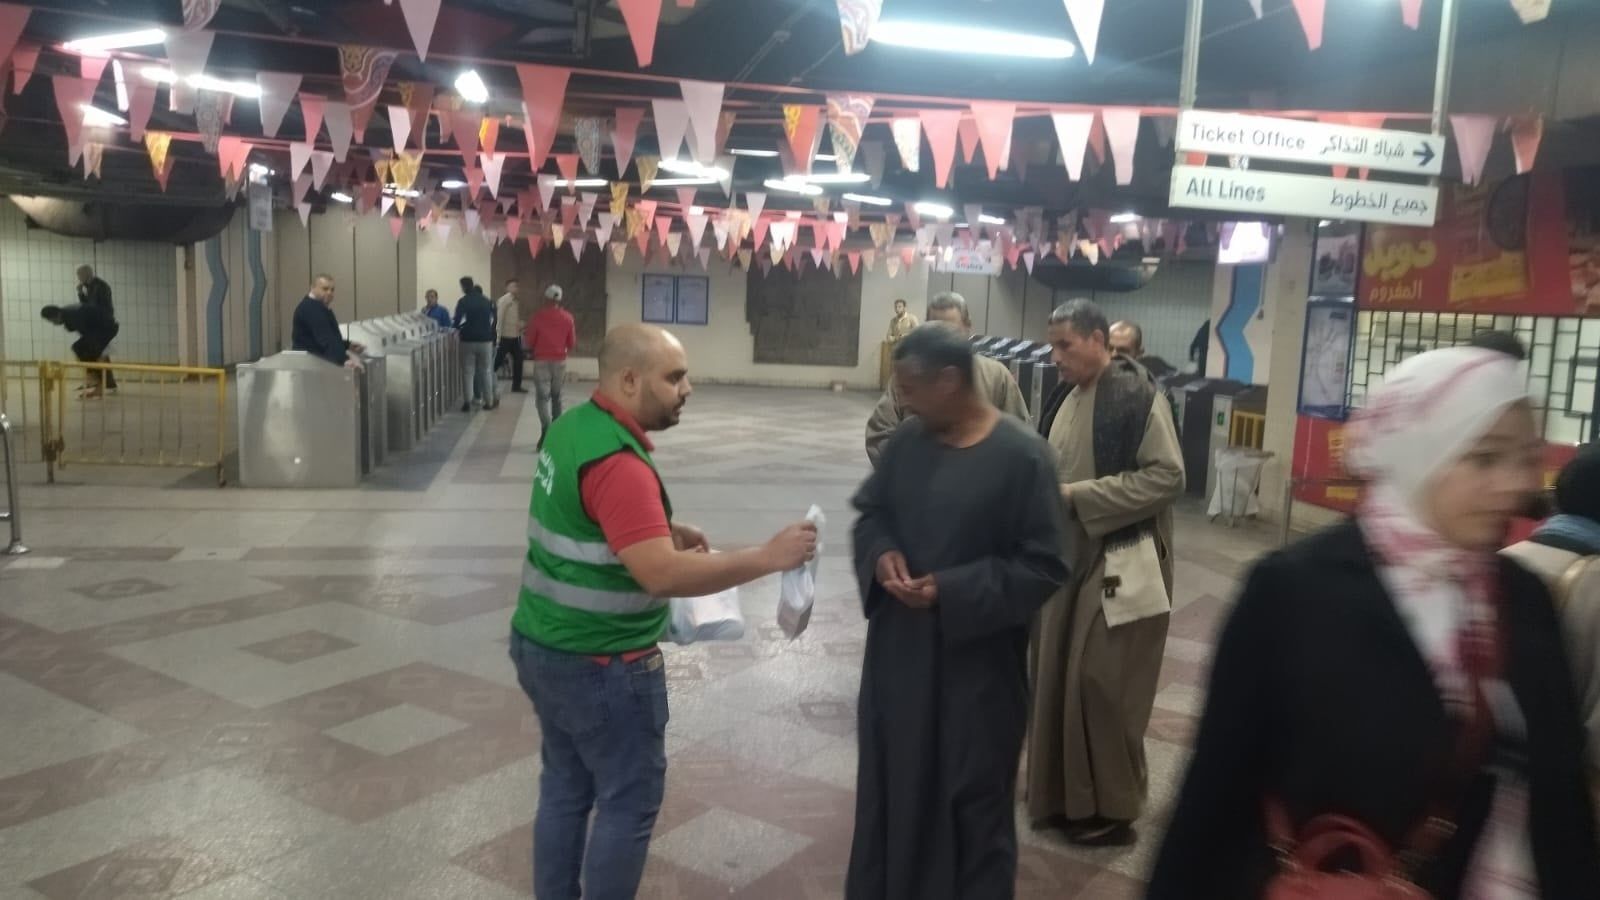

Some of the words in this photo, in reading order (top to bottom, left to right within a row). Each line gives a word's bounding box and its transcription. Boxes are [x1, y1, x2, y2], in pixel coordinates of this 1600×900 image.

[1191, 123, 1246, 144] Ticket
[1252, 130, 1305, 150] Office
[1319, 134, 1369, 155] التذاكر
[1373, 140, 1406, 160] شباك
[1186, 176, 1213, 198] All
[1218, 180, 1265, 202] Lines
[1330, 188, 1388, 212] الخطوط
[1391, 197, 1429, 216] جميع
[1368, 279, 1423, 303] المفروم
